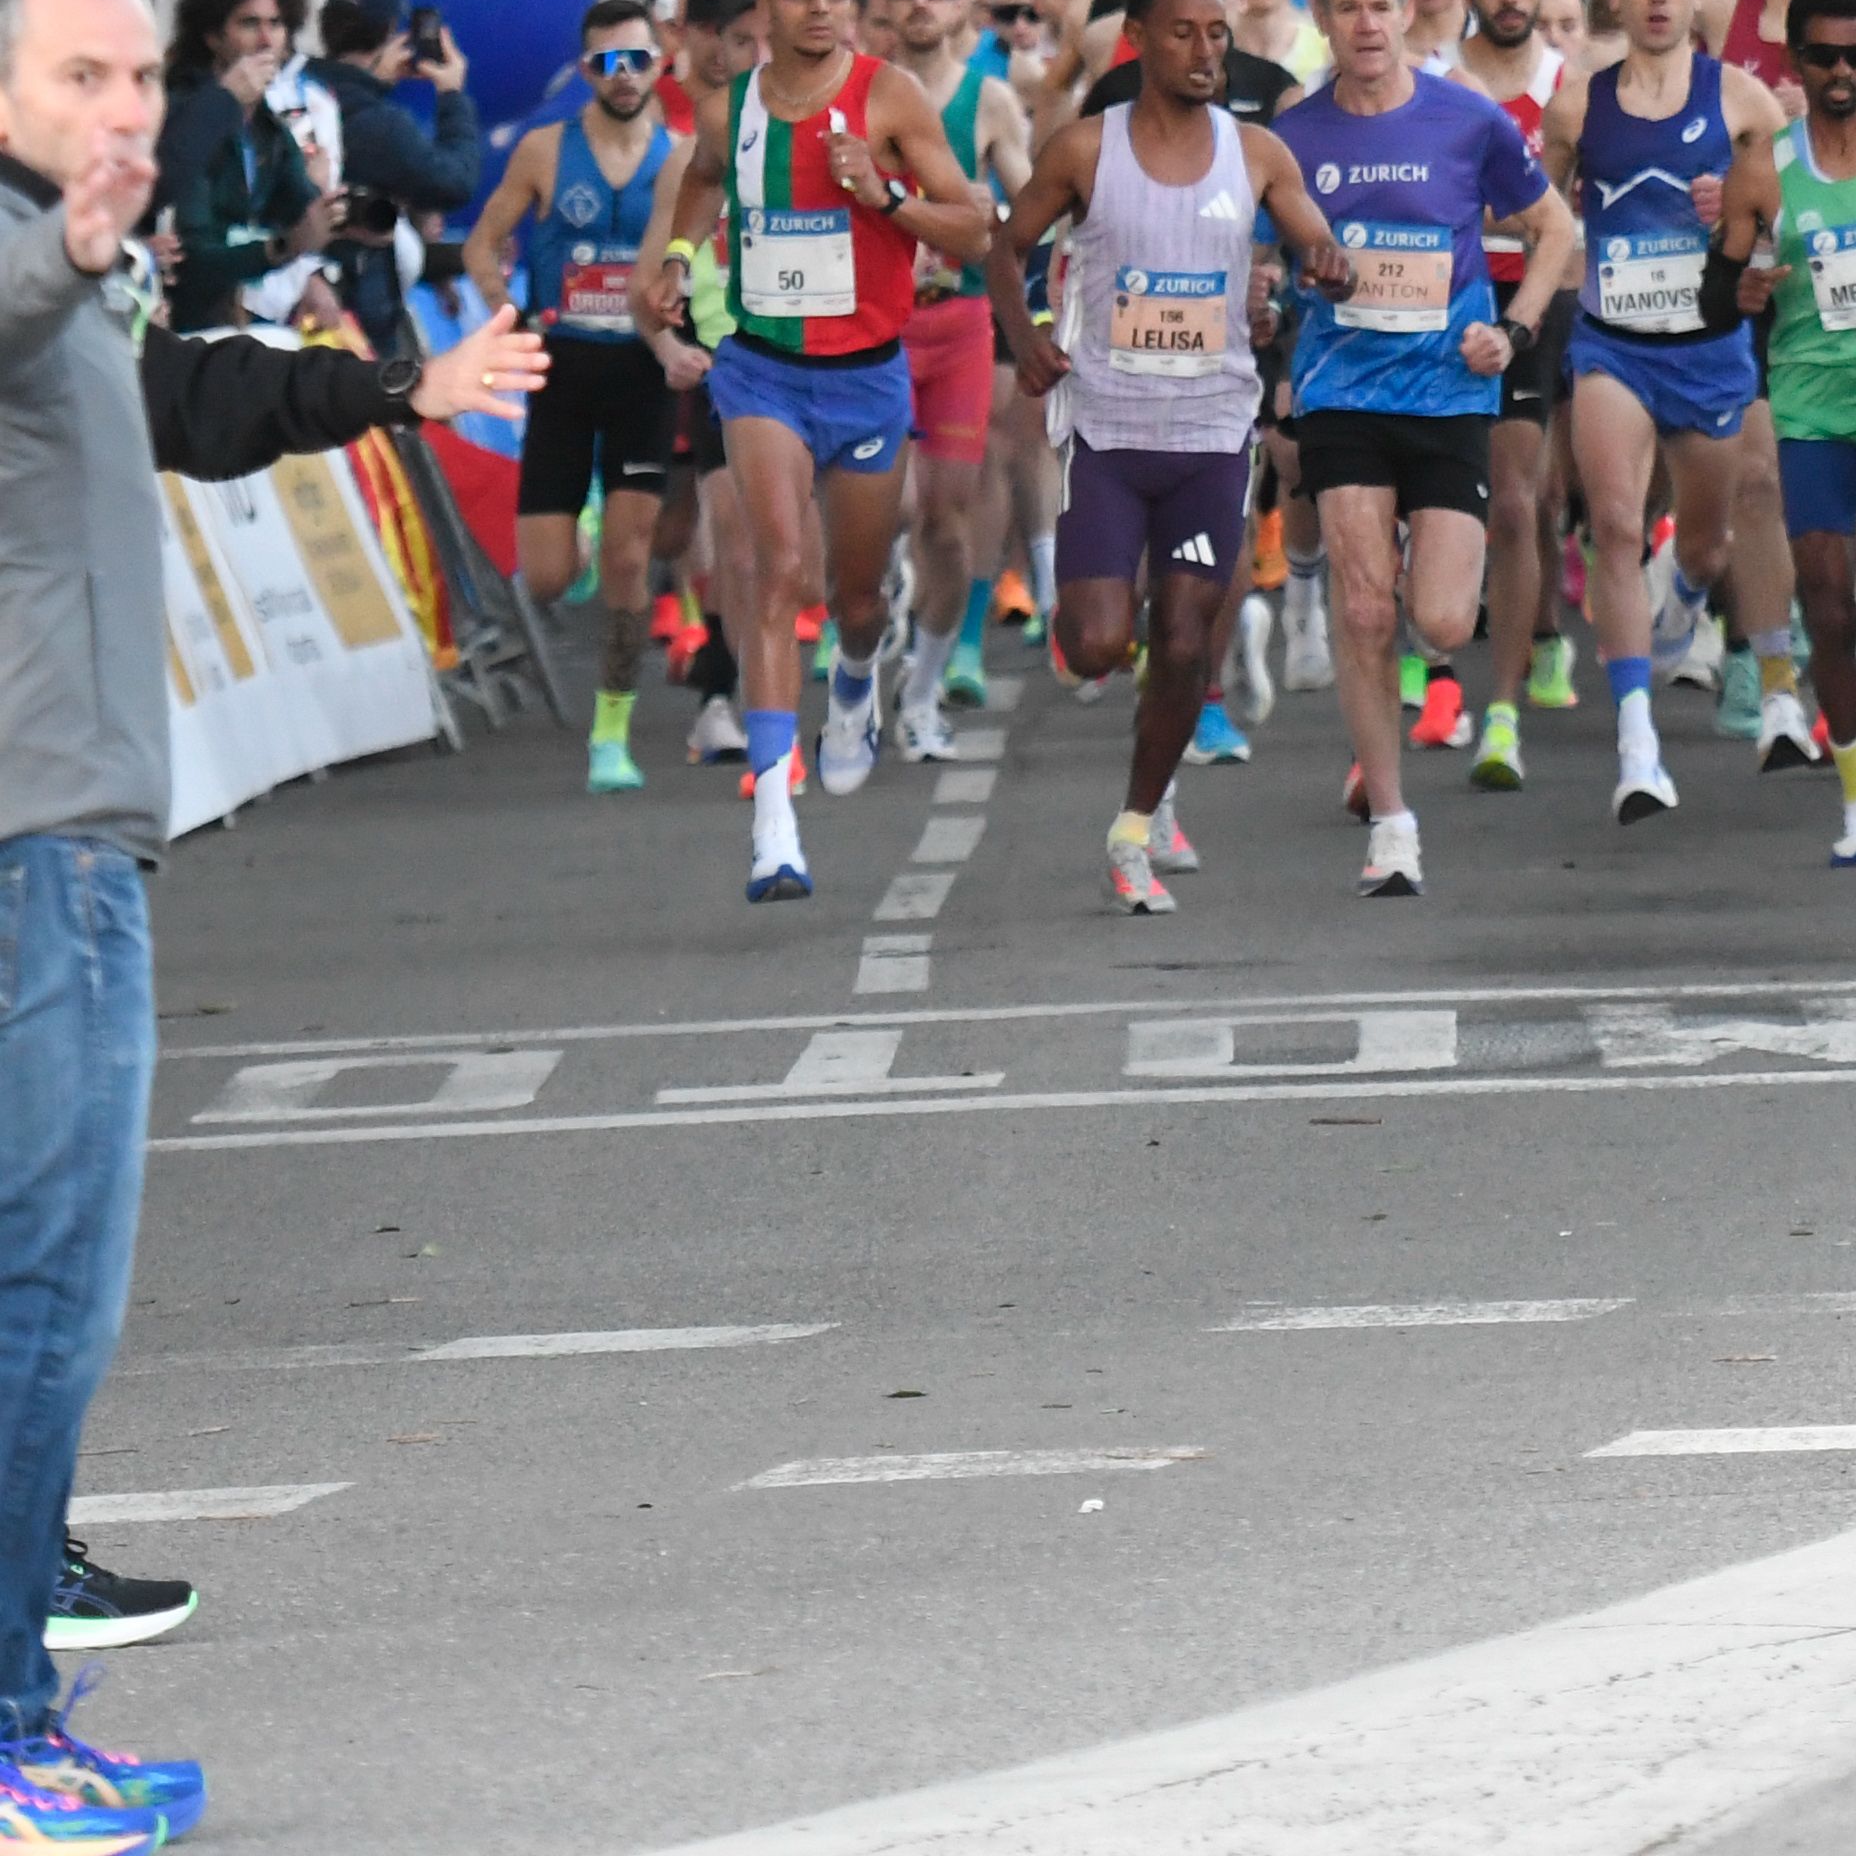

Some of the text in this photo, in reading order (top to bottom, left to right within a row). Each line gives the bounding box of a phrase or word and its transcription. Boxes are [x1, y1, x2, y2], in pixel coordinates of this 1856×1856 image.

[1349, 164, 1430, 185] ZURICH
[769, 214, 834, 233] ZURICH
[1373, 230, 1440, 248] ZURICH
[1637, 235, 1699, 256] ZURICH
[777, 269, 805, 291] 50
[1378, 263, 1404, 278] 212
[1356, 278, 1429, 299] ANTÓN
[1604, 286, 1700, 315] IVANOVS
[1131, 327, 1205, 352] LELISA
